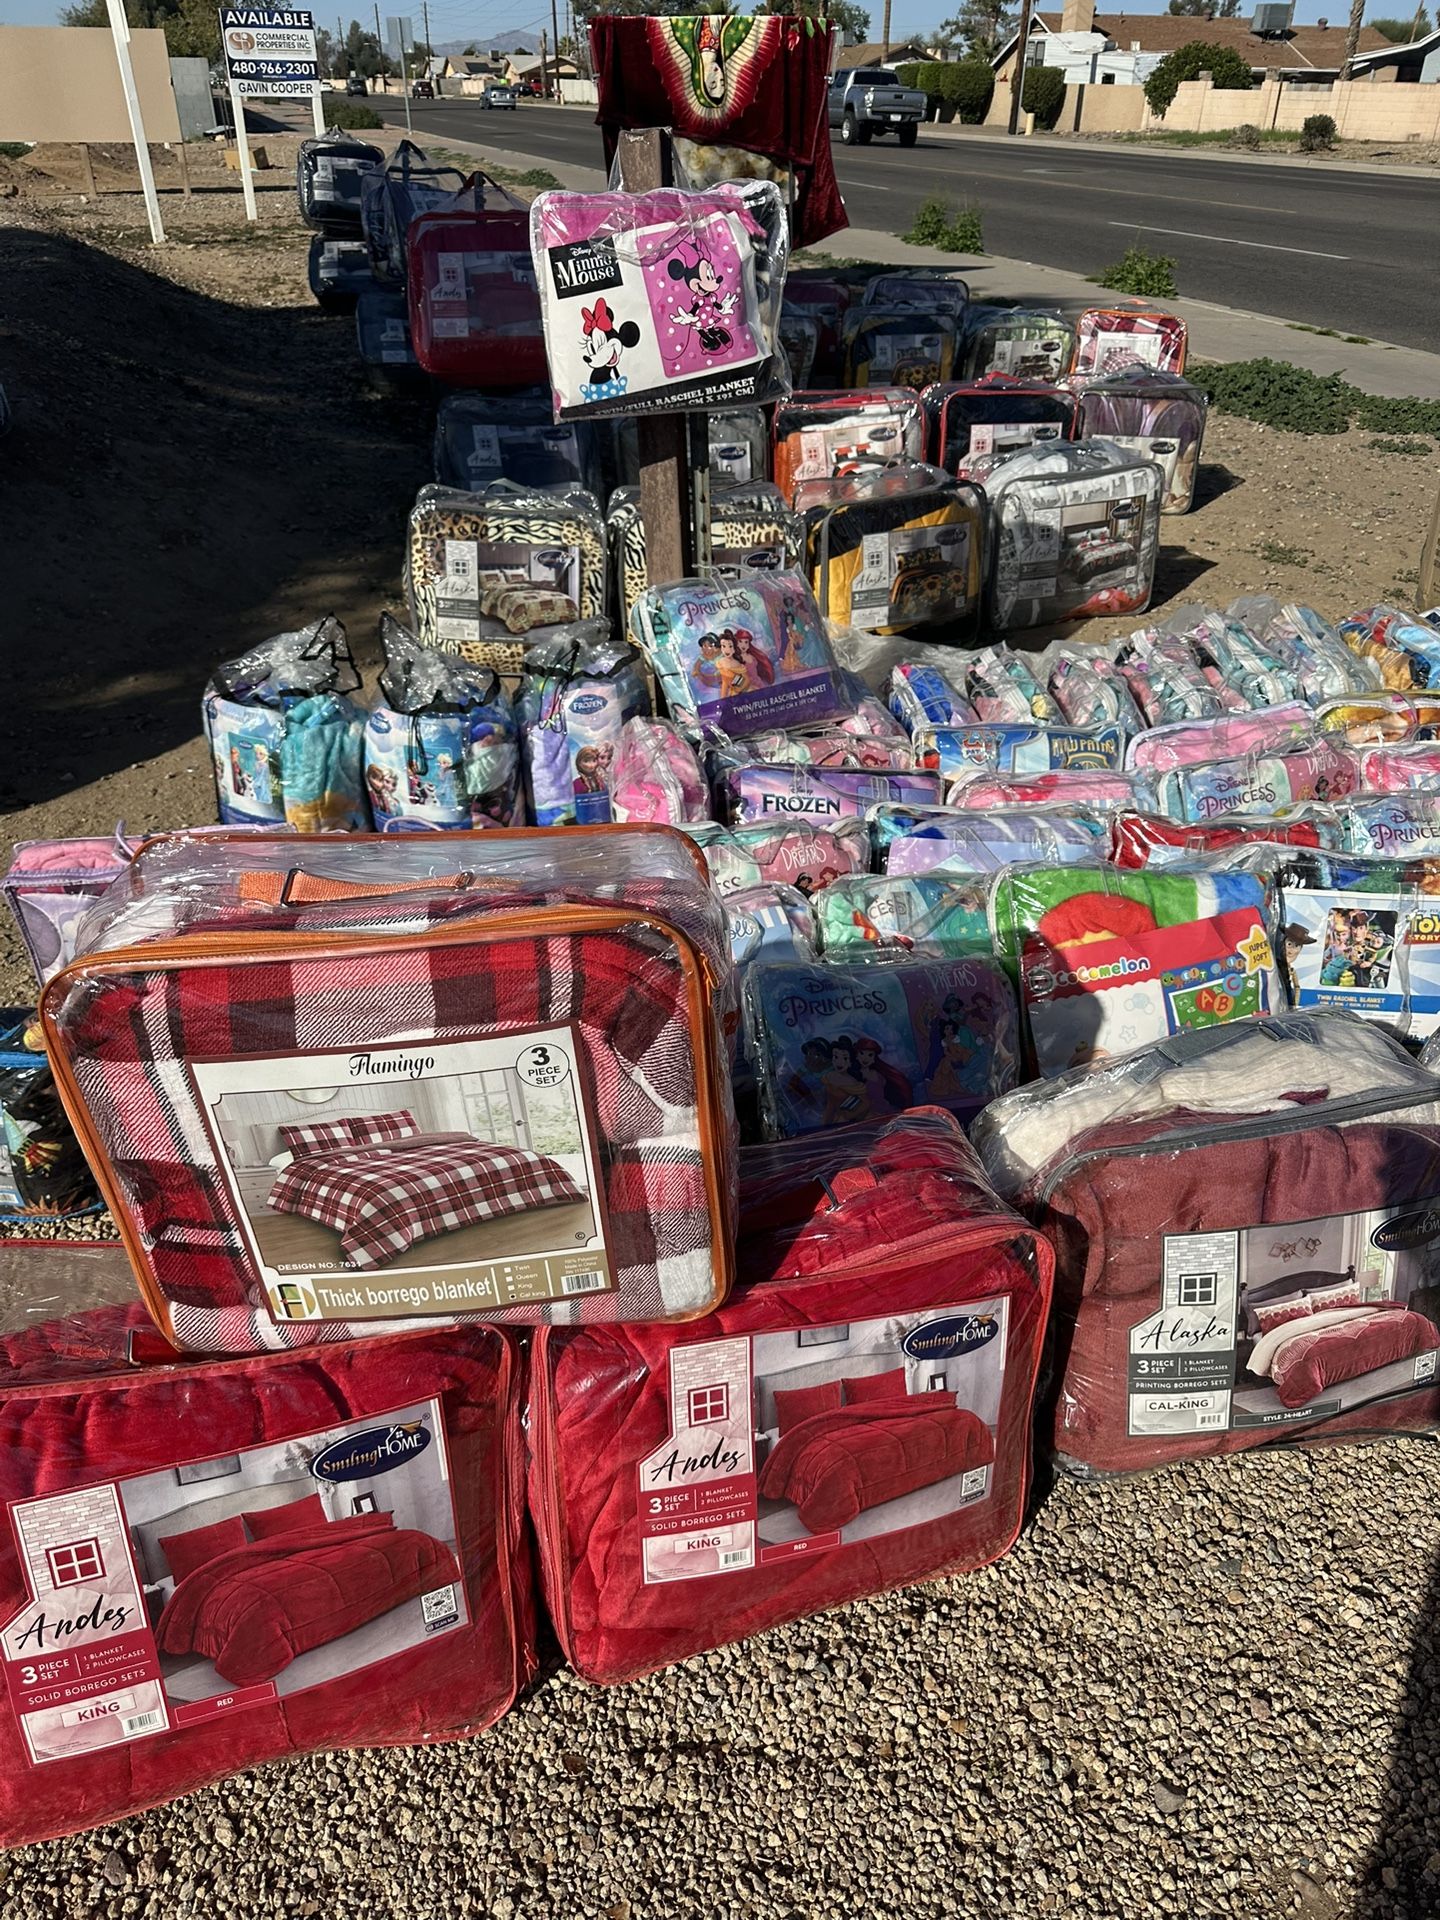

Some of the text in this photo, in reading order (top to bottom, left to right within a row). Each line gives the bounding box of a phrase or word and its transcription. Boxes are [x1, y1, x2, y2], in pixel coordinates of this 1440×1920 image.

[225, 11, 310, 26] AVAILABLE
[255, 33, 309, 41] COMMERCIAL
[256, 41, 296, 50] PROPERTIES
[232, 61, 316, 75] 480-966-2301
[238, 82, 314, 94] GAVIN COOPER
[569, 246, 592, 257] Disney
[655, 389, 705, 406] RASCHEL
[705, 376, 755, 395] BLANKET
[705, 395, 714, 403] X
[716, 391, 733, 401] 191
[735, 385, 755, 397] CM)
[677, 591, 751, 627] PRINCESS
[573, 699, 604, 711] FROZEN
[733, 683, 827, 715] TWIN/FULL RASCHEL BLANKET
[762, 793, 842, 816] FROZEN
[1196, 782, 1277, 818] PRINCESS
[1368, 822, 1440, 850] PRINCE
[780, 840, 827, 872] DREAMS
[1248, 941, 1269, 953] SUPER
[1252, 951, 1268, 963] SOFT
[778, 989, 888, 1027] PRINCESS
[531, 1046, 550, 1066] 3
[348, 1053, 435, 1080] Flamingo
[528, 1065, 561, 1077] PIECE
[535, 1075, 557, 1085] SET
[1377, 1212, 1440, 1245] SmilingHOM
[277, 1262, 316, 1271] DESIGN
[318, 1261, 337, 1269] NO:
[514, 1264, 530, 1272] Twin
[515, 1272, 538, 1281] Queen
[517, 1282, 533, 1290] King
[318, 1275, 492, 1308] Thick borrego blanket
[911, 1317, 992, 1352] SmilingHOME
[1139, 1315, 1231, 1350] Alaska
[1136, 1359, 1151, 1375] 3
[1151, 1359, 1175, 1367] PIECE
[1188, 1358, 1214, 1366] BLANKET
[1151, 1366, 1166, 1374] SET
[1135, 1379, 1228, 1390] PRINTING BORREGO SETS
[1148, 1398, 1209, 1411] CAL-KING
[321, 1424, 423, 1475] SmilingHOME
[650, 1436, 746, 1482] Andes
[649, 1497, 663, 1514] 3
[664, 1492, 690, 1504] PIECE
[705, 1486, 734, 1497] BLANKET
[664, 1502, 681, 1512] SET
[707, 1490, 749, 1504] PILLOWCASES
[651, 1508, 746, 1532] SOLID BORREGO SETS
[686, 1536, 721, 1551] KING
[793, 1542, 808, 1551] RED
[14, 1593, 135, 1651] Andes
[20, 1665, 38, 1685] 3
[38, 1658, 71, 1673] PIECE
[89, 1644, 125, 1661] BLANKET
[40, 1670, 60, 1681] SET
[92, 1648, 146, 1669] PILLOWCASES
[28, 1668, 146, 1706] SOLID BORREGO SETS
[77, 1701, 121, 1721] KING
[216, 1696, 234, 1708] RED
